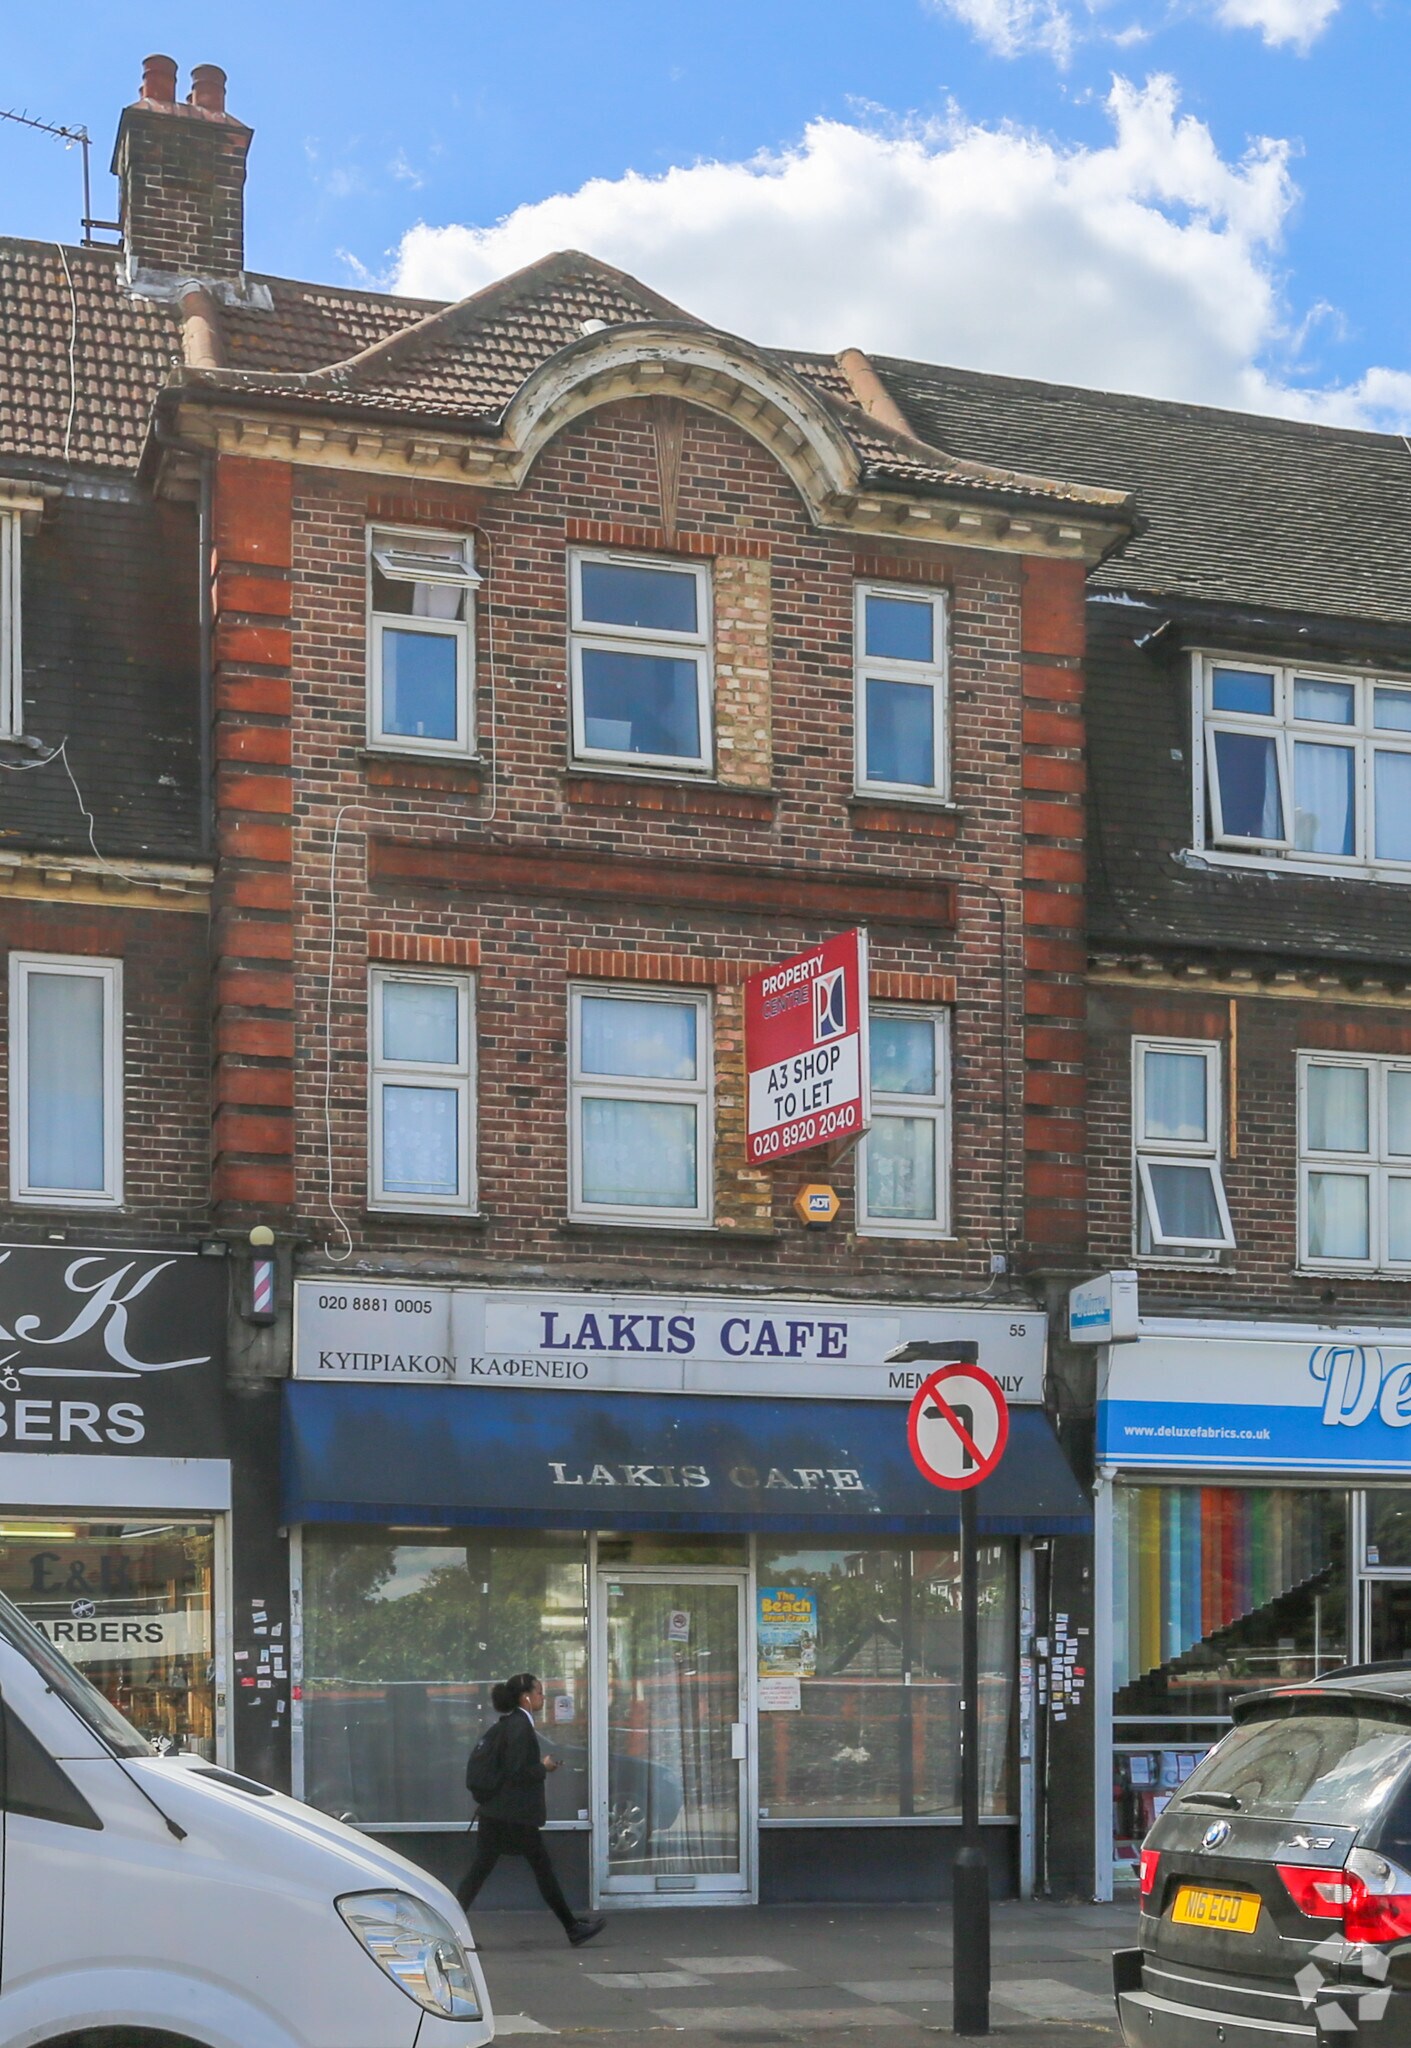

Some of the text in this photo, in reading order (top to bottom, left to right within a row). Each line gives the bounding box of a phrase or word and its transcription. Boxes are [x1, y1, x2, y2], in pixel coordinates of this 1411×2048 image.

[762, 954, 824, 997] PROPERTY
[762, 985, 809, 1019] CENTRE
[767, 1046, 840, 1094] A3 SHOP
[774, 1079, 833, 1121] TO LET
[753, 1105, 855, 1156] 020 8920 2040
[809, 1198, 830, 1211] ADT
[318, 1295, 432, 1314] 020 8881 0005
[540, 1311, 848, 1359] LAKIS CAFE
[1009, 1324, 1026, 1338] 55
[318, 1351, 589, 1380] ΚΥΠΡΙΑΚΟΝ ΚΑΦΕΝΕΙΟ
[994, 1375, 1024, 1393] NLY
[0, 1399, 145, 1444] ERS
[1124, 1424, 1270, 1440] www.deluxefabrics.co.uk
[548, 1462, 864, 1491] LAKIS CAFE
[761, 1598, 811, 1614] Beach
[777, 1590, 797, 1601] The
[1287, 1833, 1335, 1850] X3
[1184, 1890, 1208, 1918] N16
